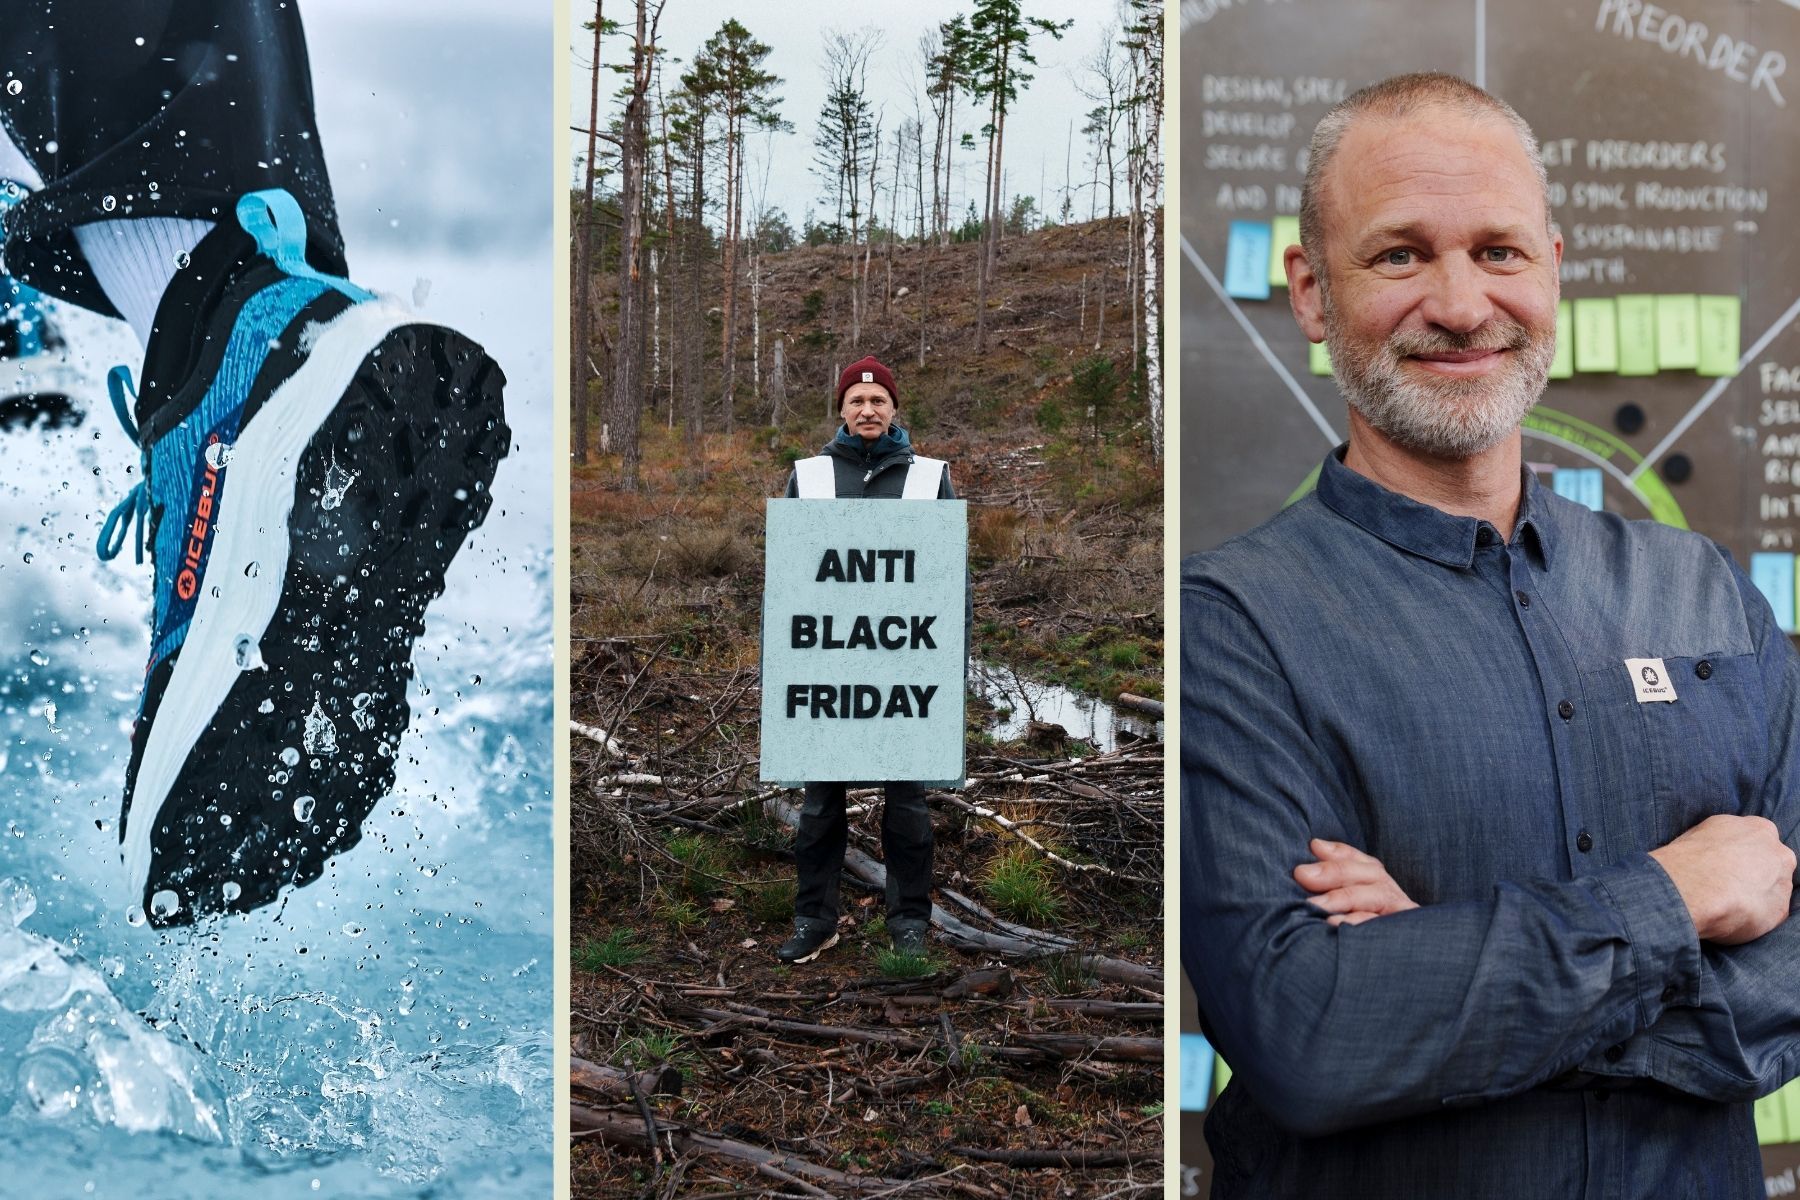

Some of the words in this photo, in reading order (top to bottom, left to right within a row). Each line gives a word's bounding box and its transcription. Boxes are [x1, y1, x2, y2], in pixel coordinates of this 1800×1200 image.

[1595, 0, 1786, 107] PREORDER
[1202, 110, 1296, 138] DEVELOP
[1204, 144, 1286, 171] SECURE
[1540, 138, 1577, 167] ET
[1586, 139, 1727, 173] PREORDERS
[1216, 183, 1267, 211] AND
[1635, 181, 1768, 212] PRODUCTION
[1572, 223, 1722, 253] SUSTAINABLE
[185, 446, 219, 570] ICEBU
[815, 549, 915, 583] ANTI
[791, 615, 938, 650] BLACK
[786, 684, 938, 719] FRIDAY
